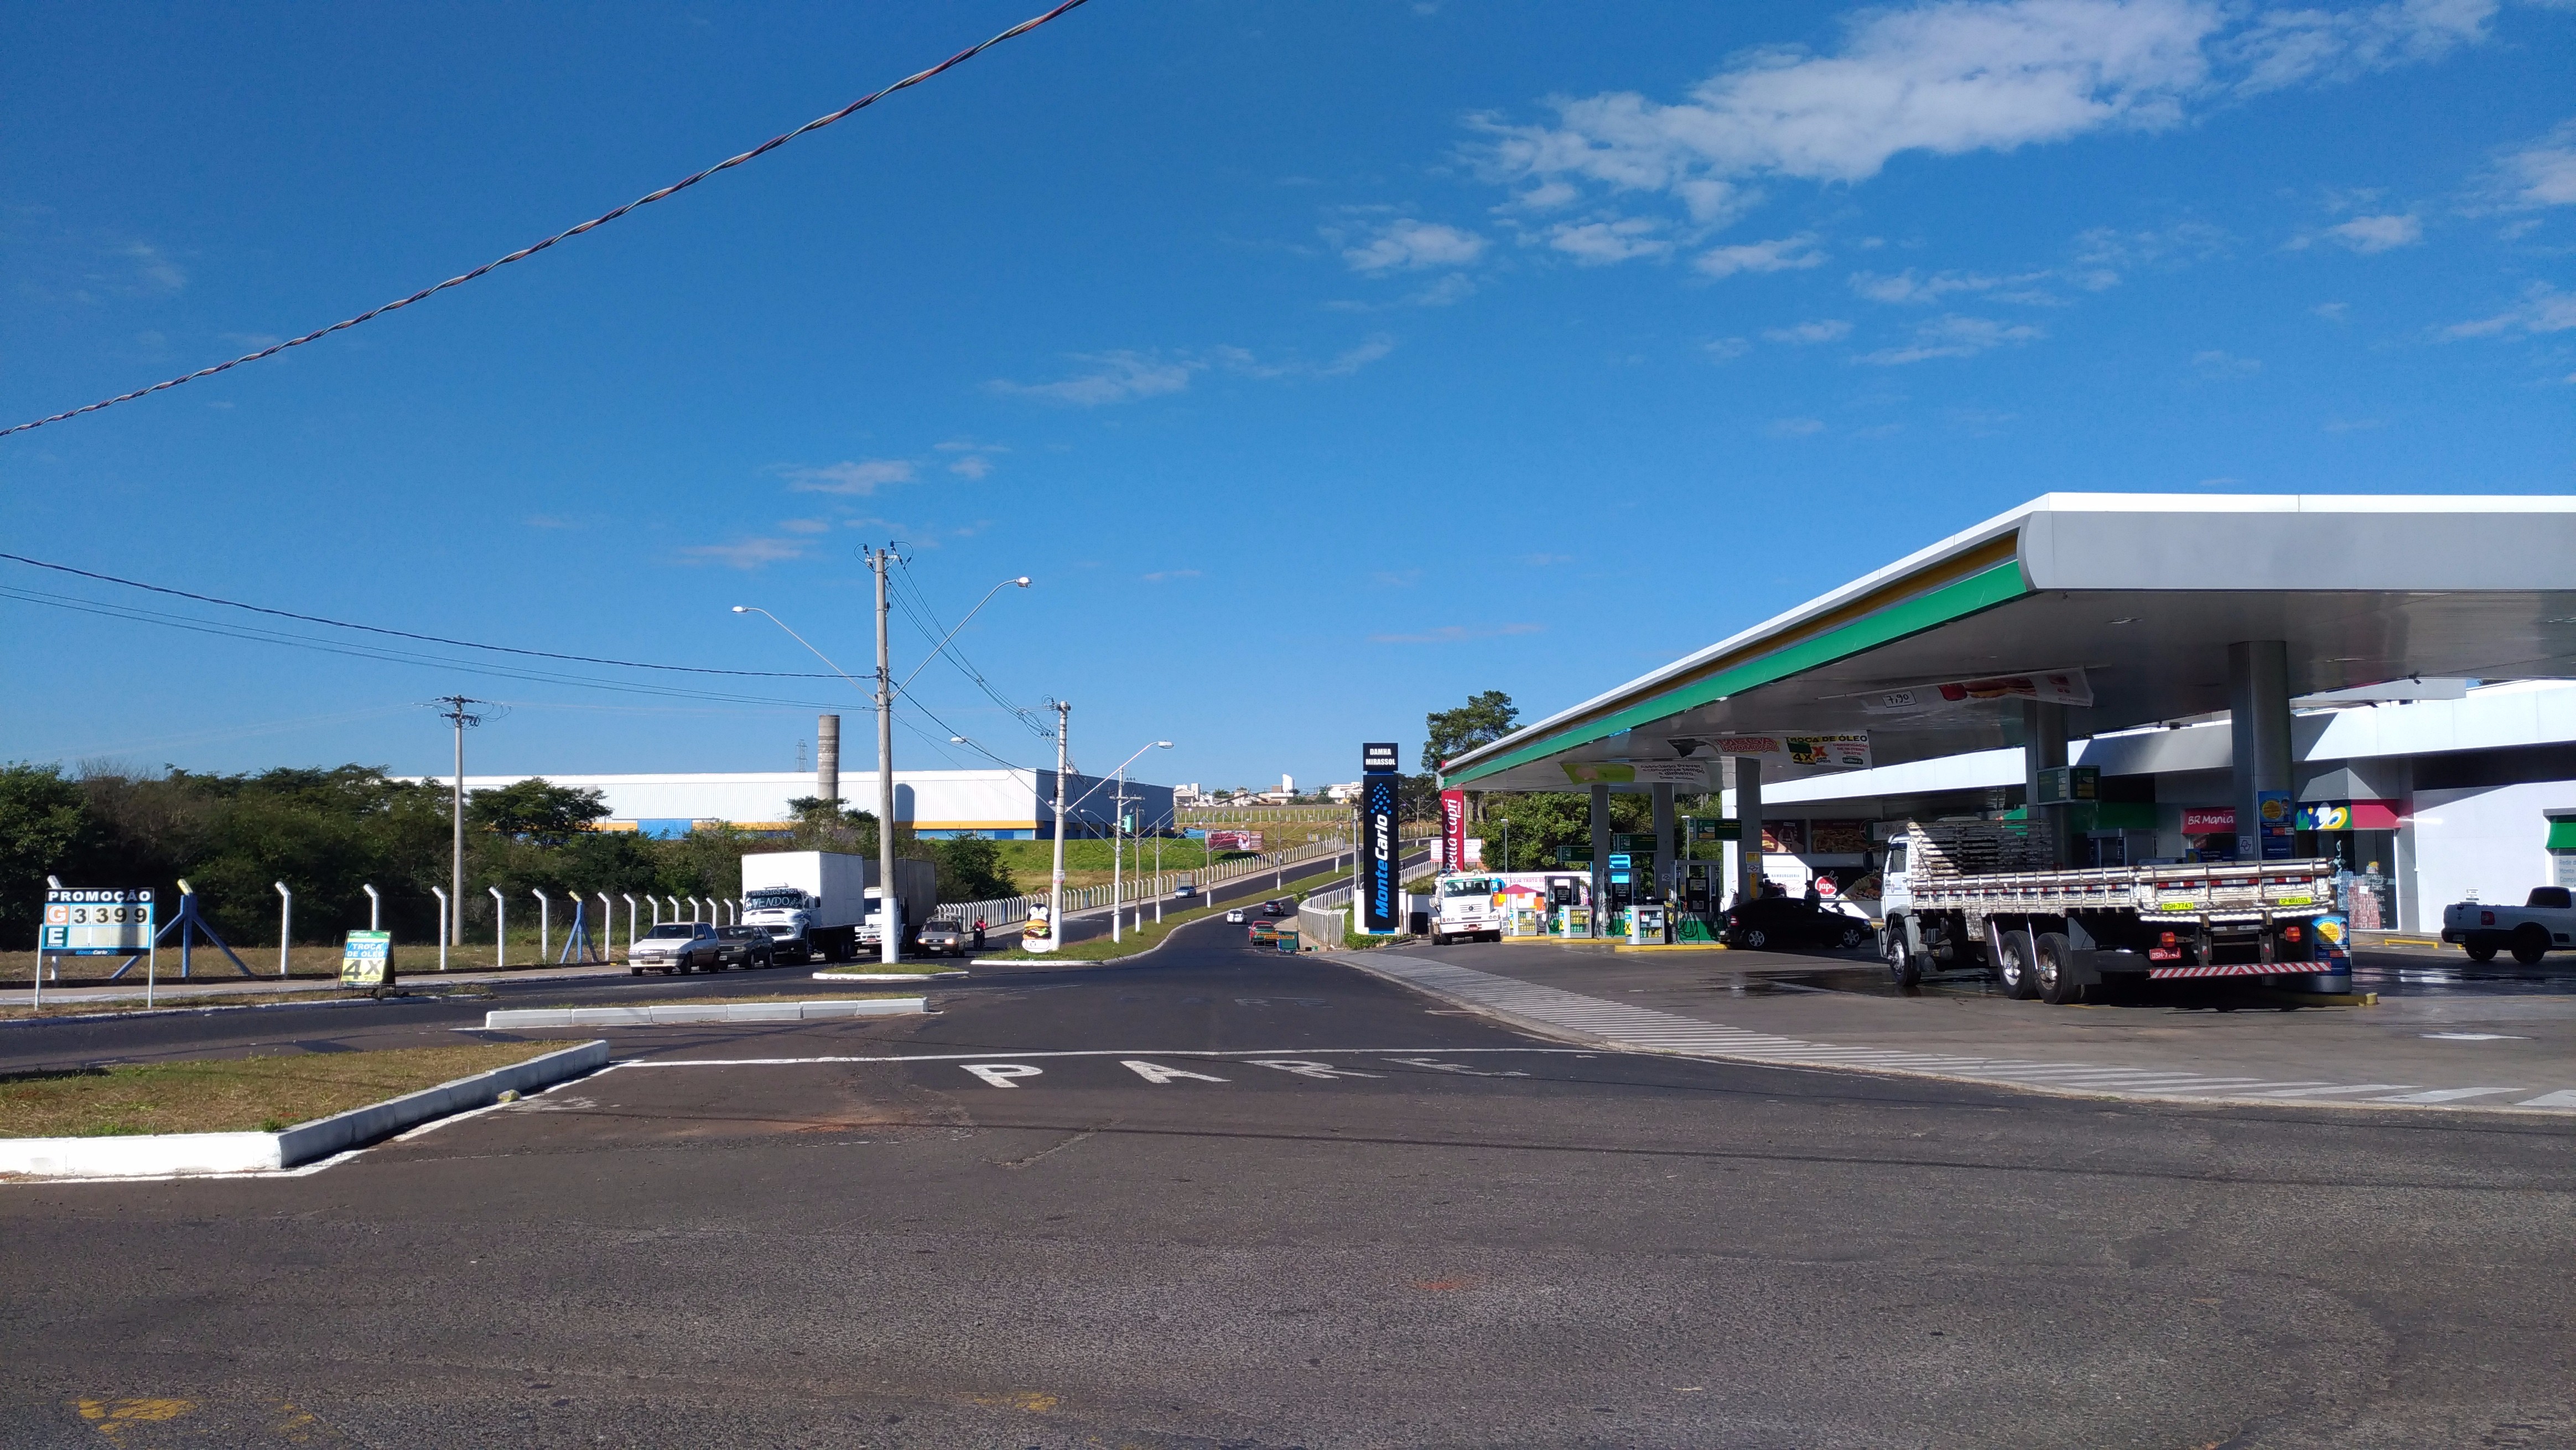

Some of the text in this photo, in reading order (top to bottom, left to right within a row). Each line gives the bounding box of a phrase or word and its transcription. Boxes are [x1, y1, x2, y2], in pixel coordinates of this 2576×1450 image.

[1887, 694, 1909, 704] 7,90
[1838, 734, 1867, 742] ÓLEO
[2188, 813, 2234, 825] BR Mania
[1445, 799, 1461, 871] Bella Capri
[1375, 814, 1388, 919] MonteCarlo
[48, 889, 150, 903] PROMOÇÃO
[752, 897, 790, 908] VENDO
[49, 905, 66, 922] G
[48, 928, 64, 944] E
